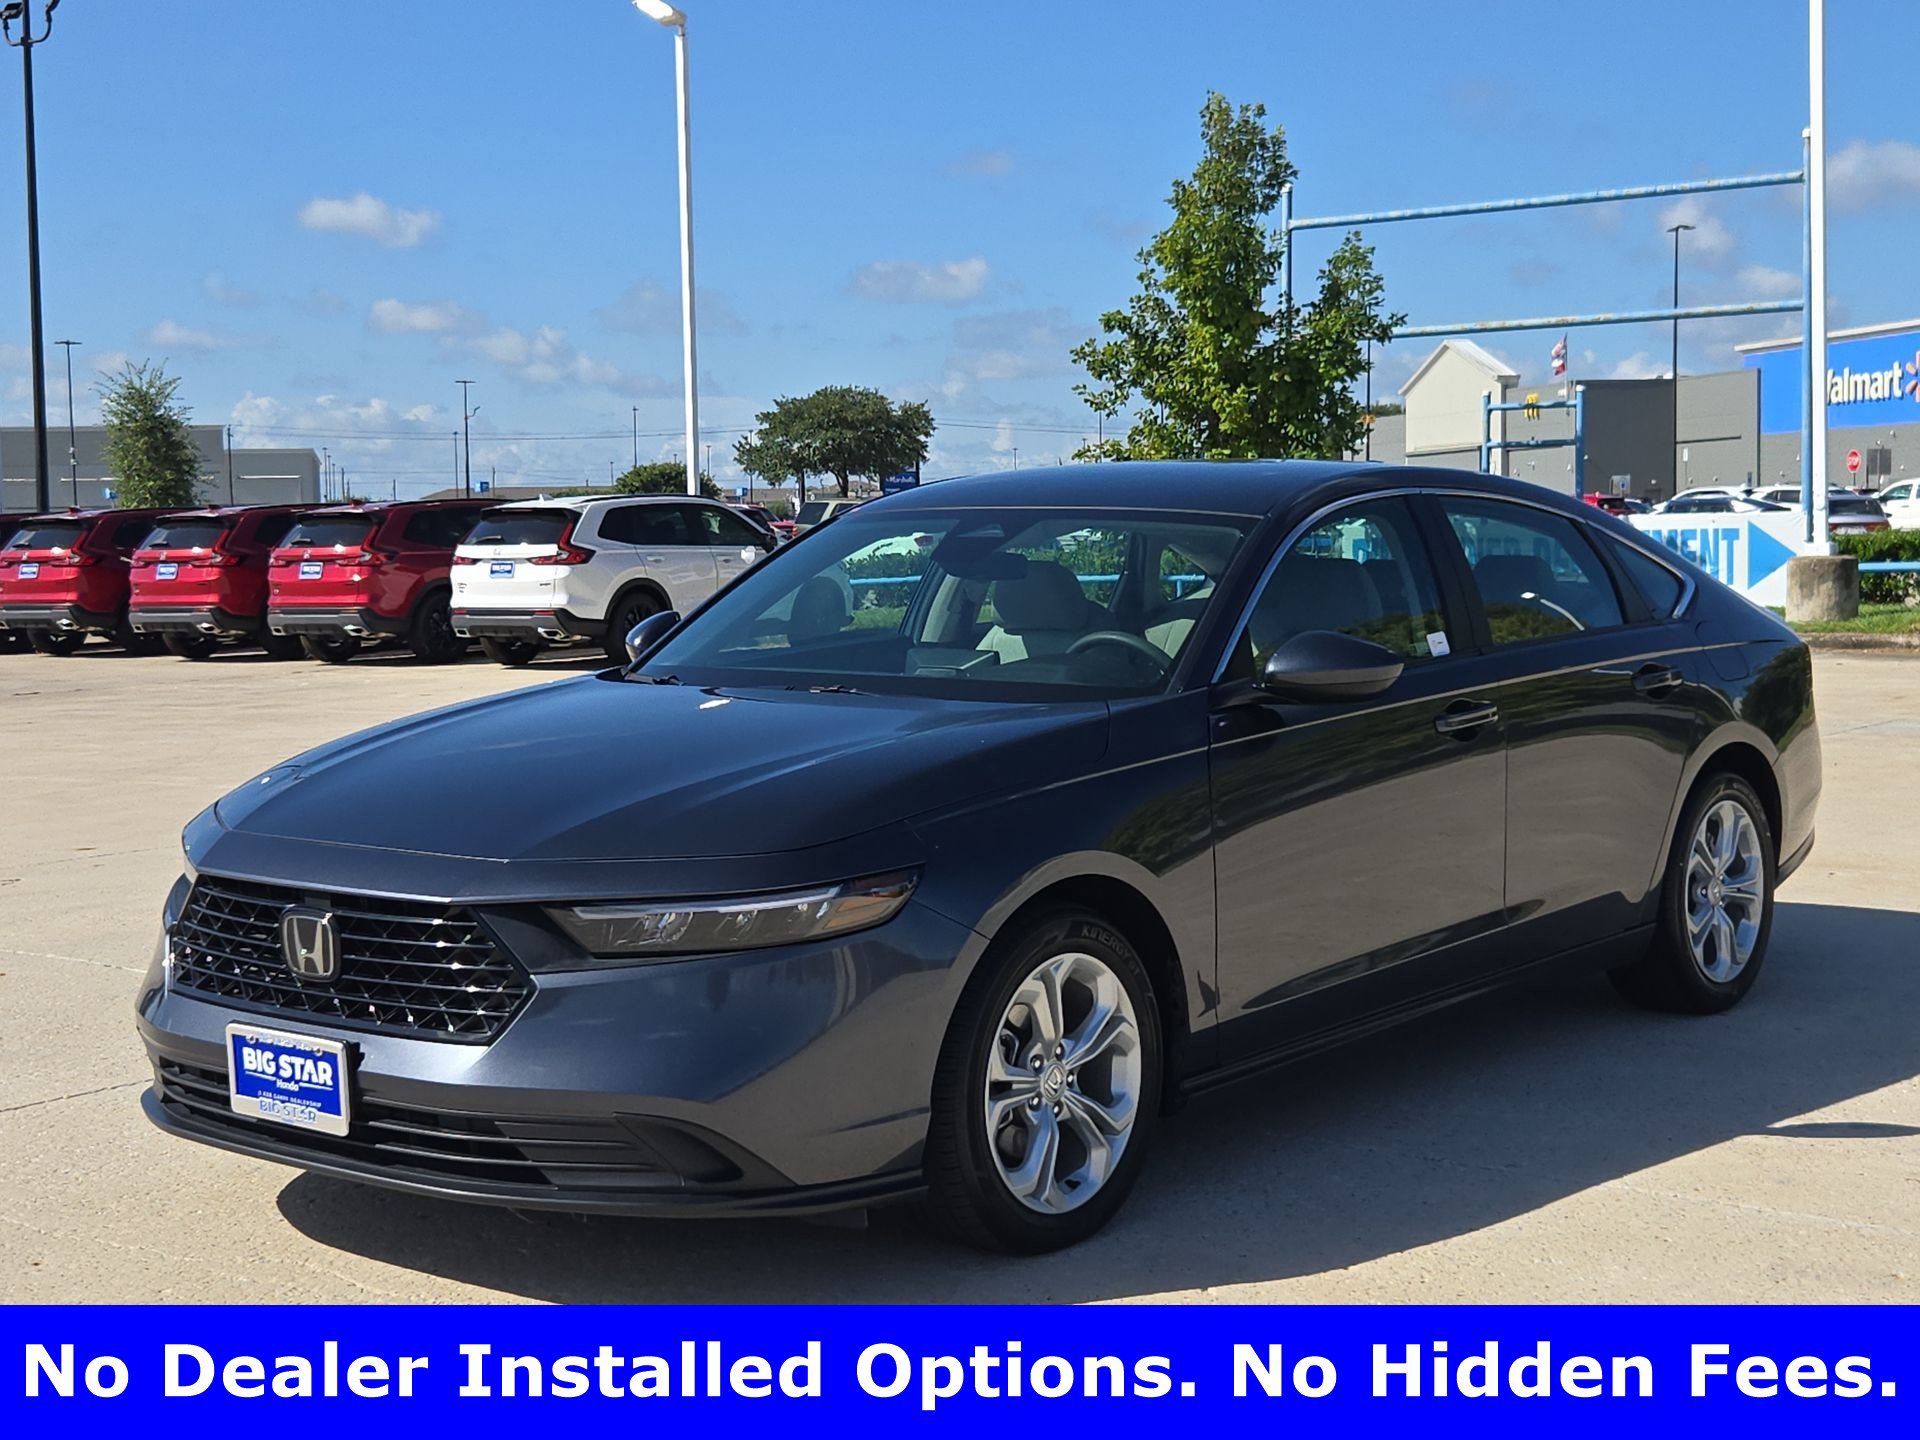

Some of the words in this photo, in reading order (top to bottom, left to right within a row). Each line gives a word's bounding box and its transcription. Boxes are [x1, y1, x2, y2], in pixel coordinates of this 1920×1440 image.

[242, 1047, 276, 1075] BIG
[278, 1054, 333, 1086] STAR
[276, 1079, 299, 1091] Honda
